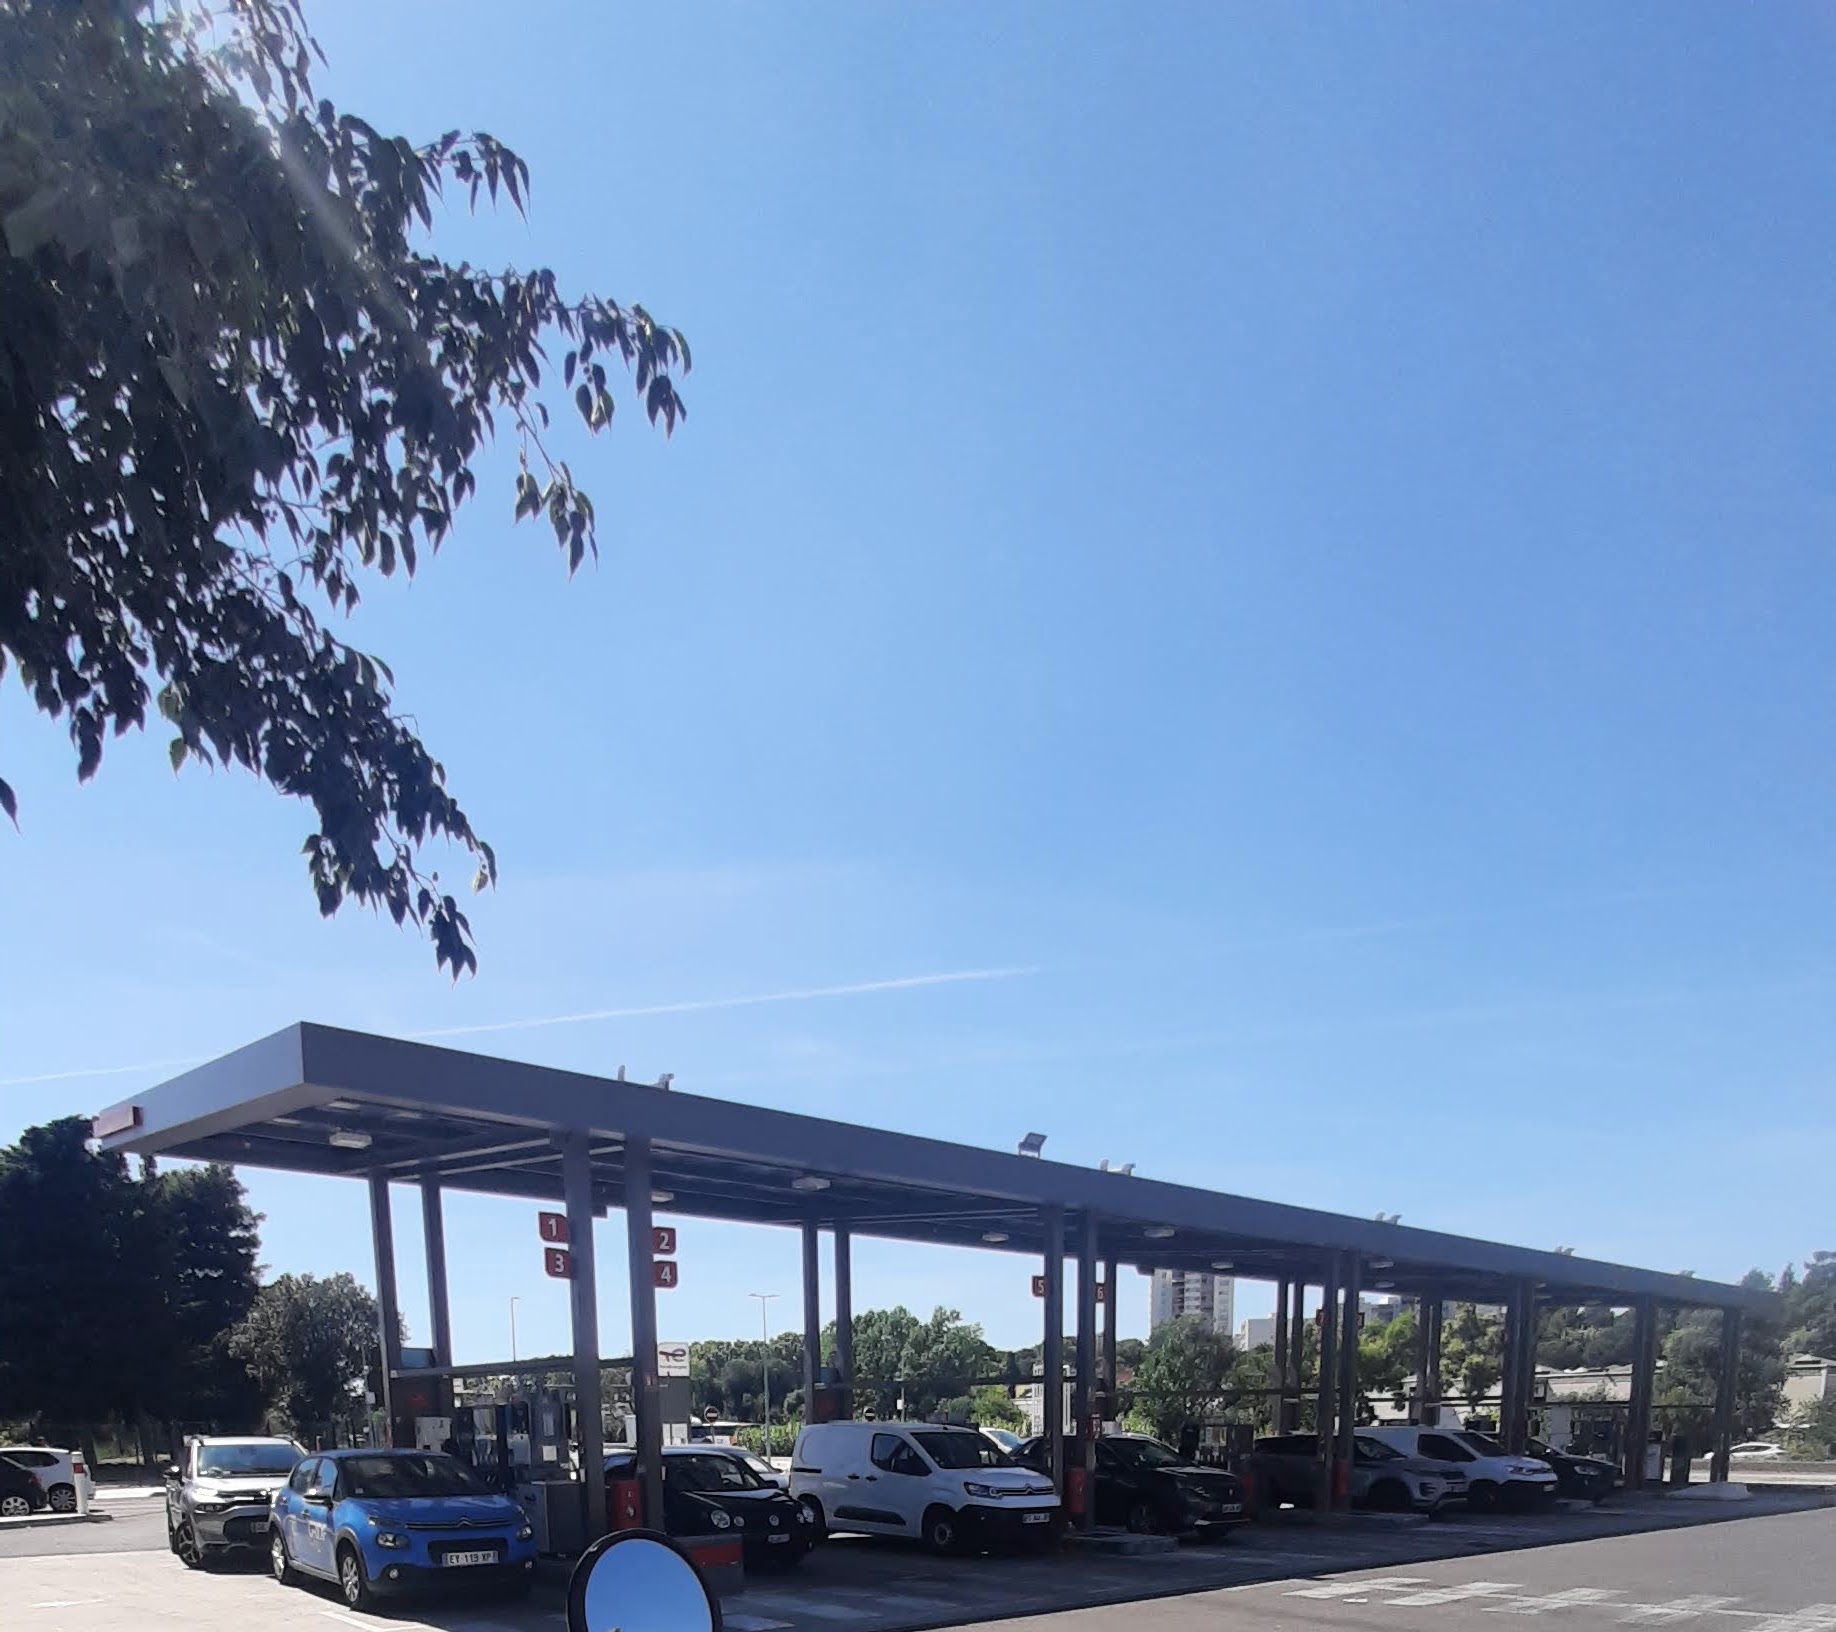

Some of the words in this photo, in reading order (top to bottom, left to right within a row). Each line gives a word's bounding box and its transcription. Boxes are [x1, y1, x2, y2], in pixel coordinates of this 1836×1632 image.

[548, 1218, 557, 1237] 1
[659, 1232, 670, 1250] 2
[555, 1253, 565, 1273] 3
[660, 1266, 672, 1283] 4
[1037, 1279, 1045, 1294] 5
[1097, 1286, 1104, 1300] 6
